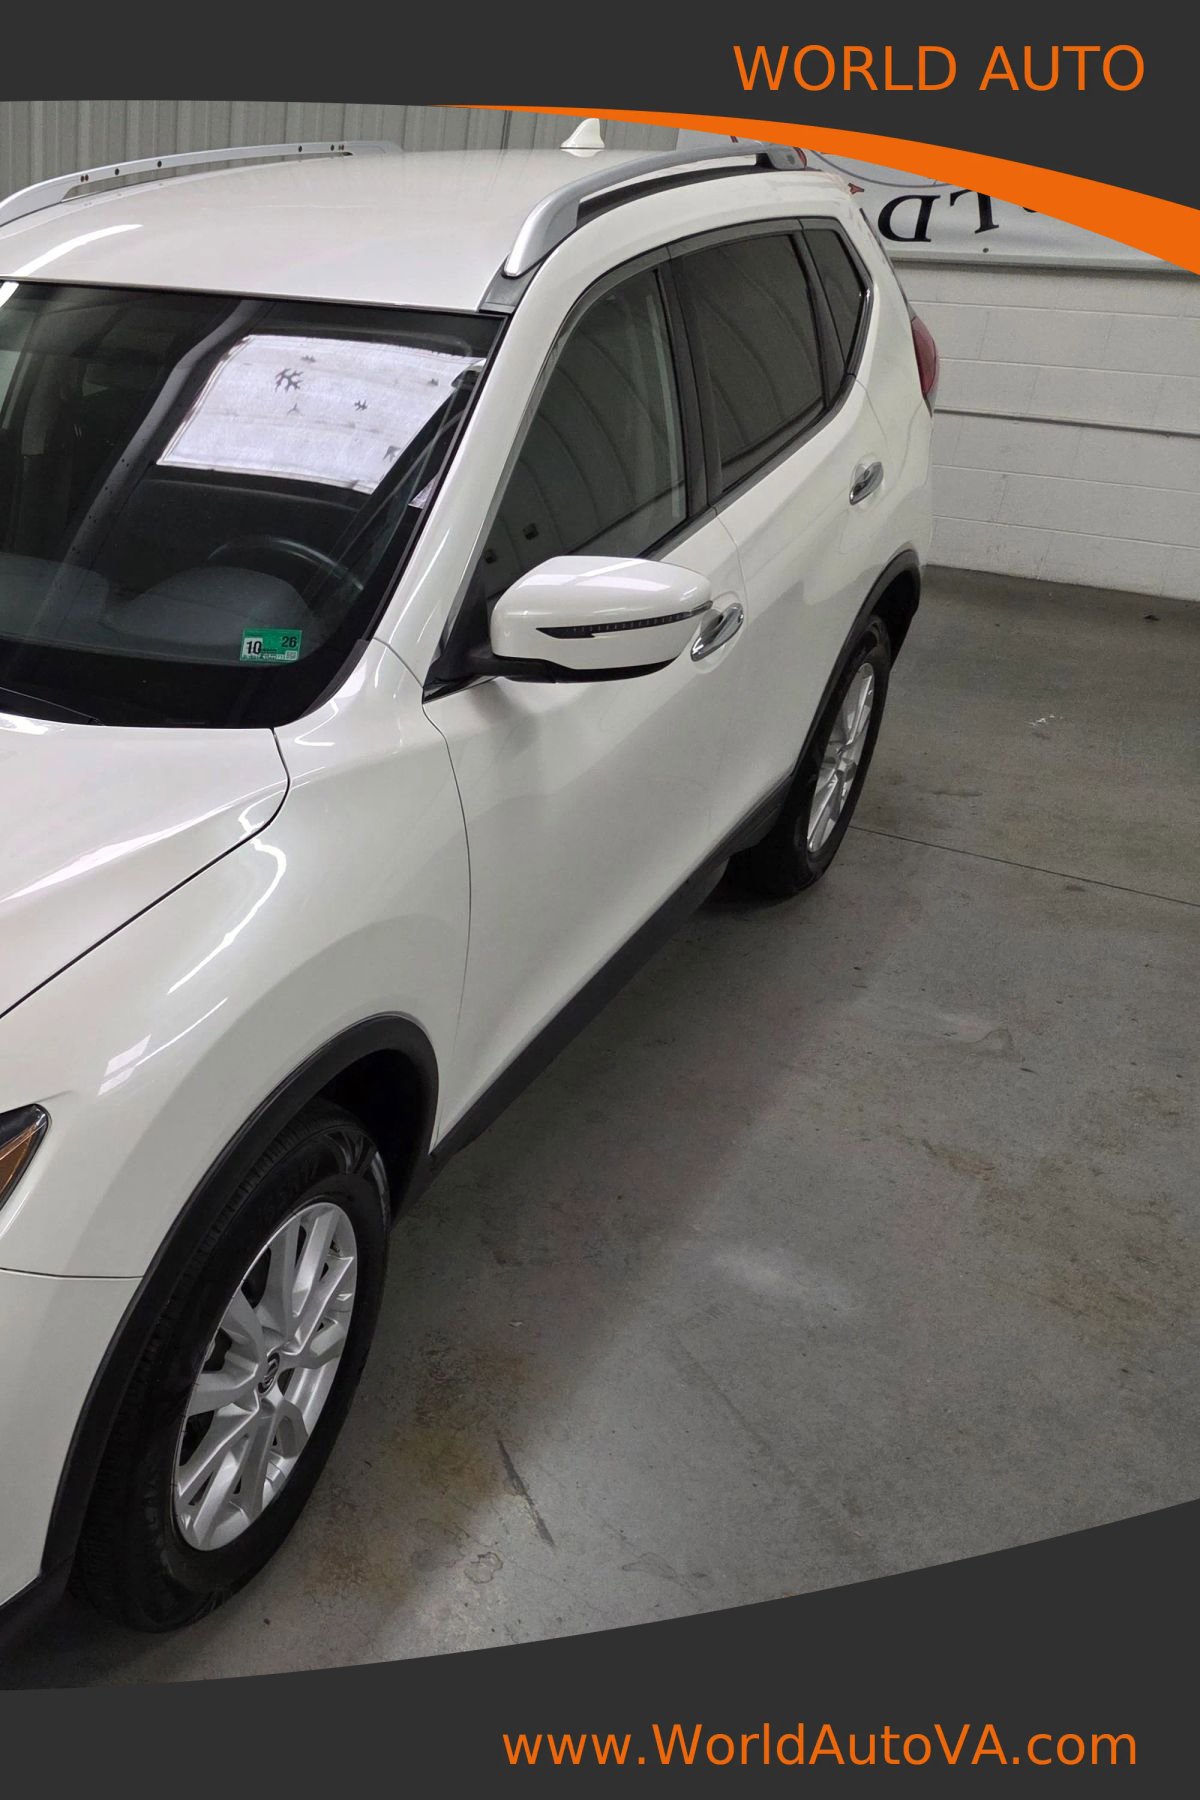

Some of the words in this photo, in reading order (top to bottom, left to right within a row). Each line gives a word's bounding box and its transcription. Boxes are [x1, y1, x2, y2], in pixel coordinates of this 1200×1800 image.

[877, 188, 1037, 242] LD
[246, 640, 262, 655] 10
[281, 635, 298, 648] 26
